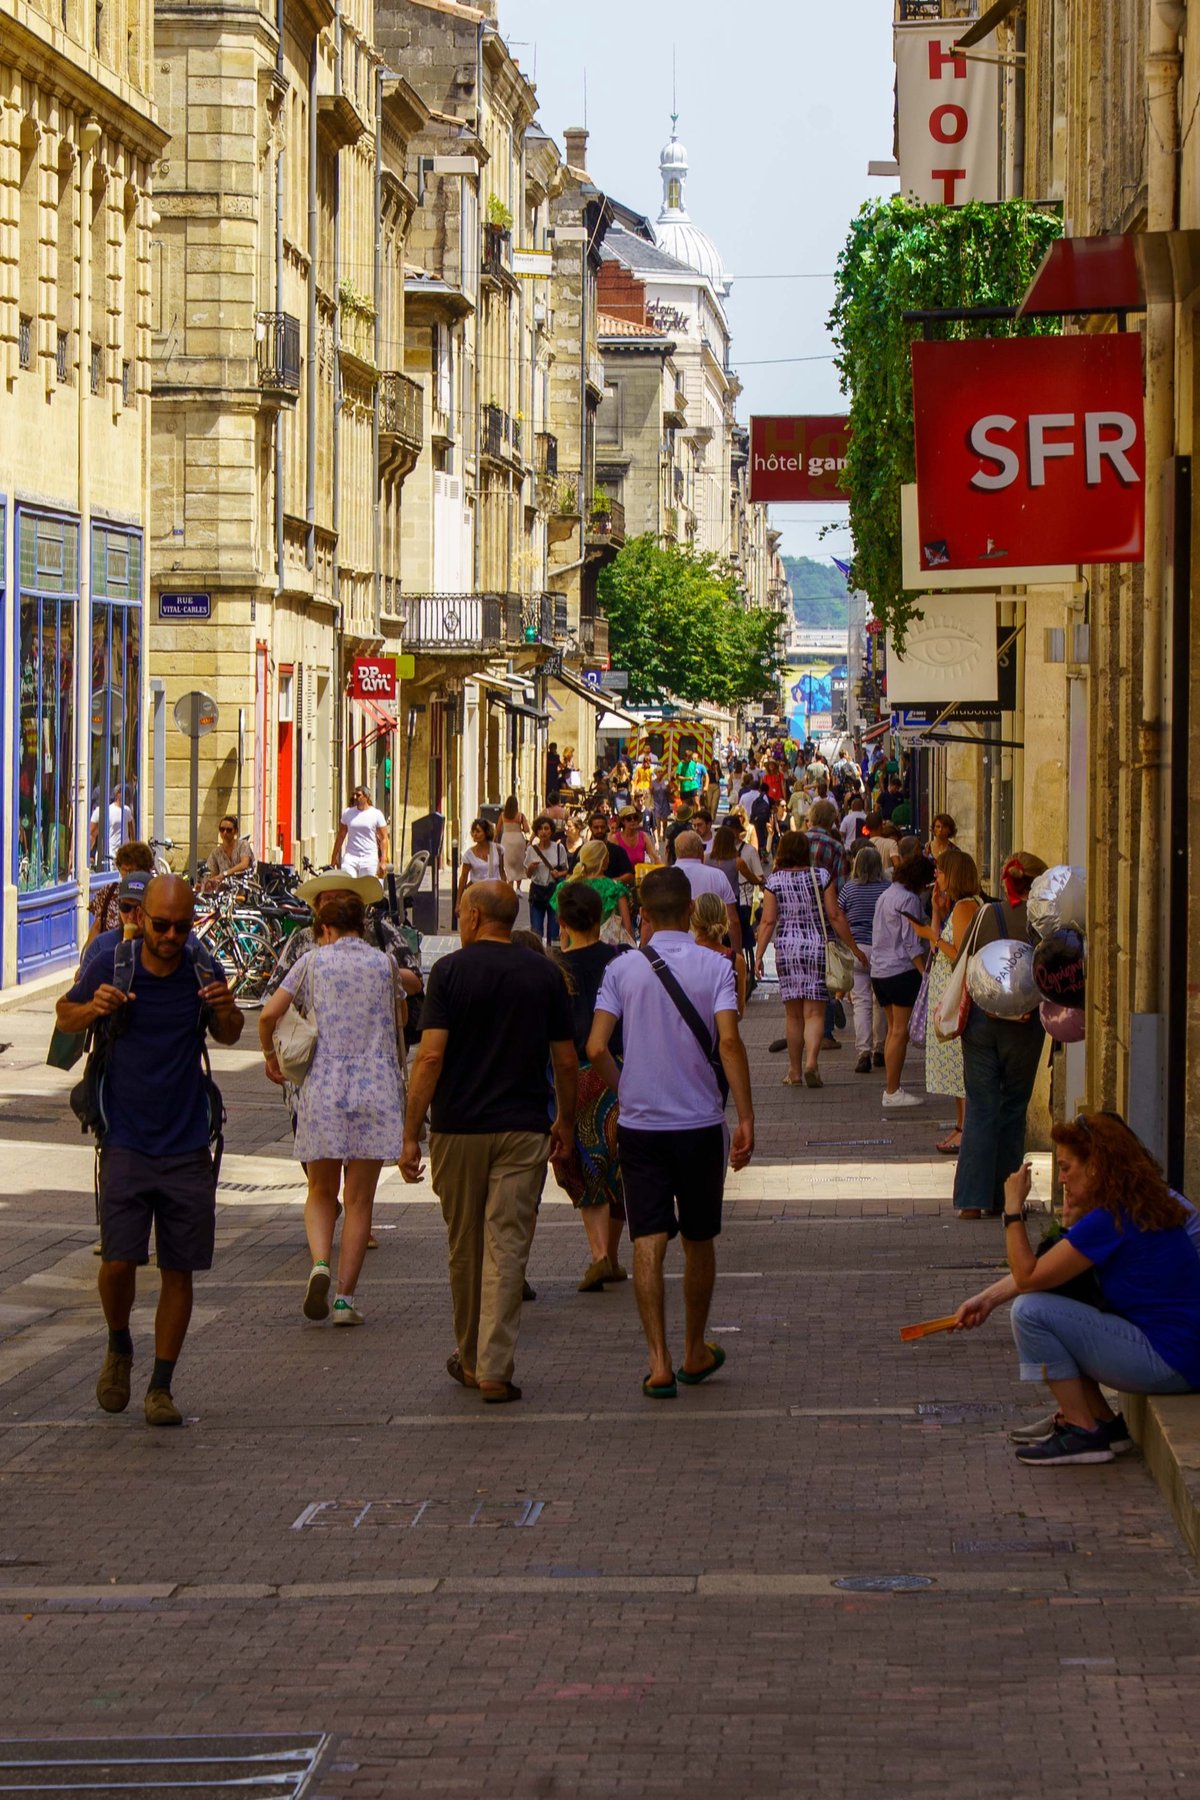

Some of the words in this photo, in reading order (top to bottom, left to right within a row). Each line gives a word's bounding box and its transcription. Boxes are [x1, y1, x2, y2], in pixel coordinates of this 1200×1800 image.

[971, 411, 1140, 489] SFR
[754, 453, 802, 471] hôtel
[176, 596, 194, 605] RUE
[361, 677, 391, 692] am
[995, 944, 1033, 985] PANDORA
